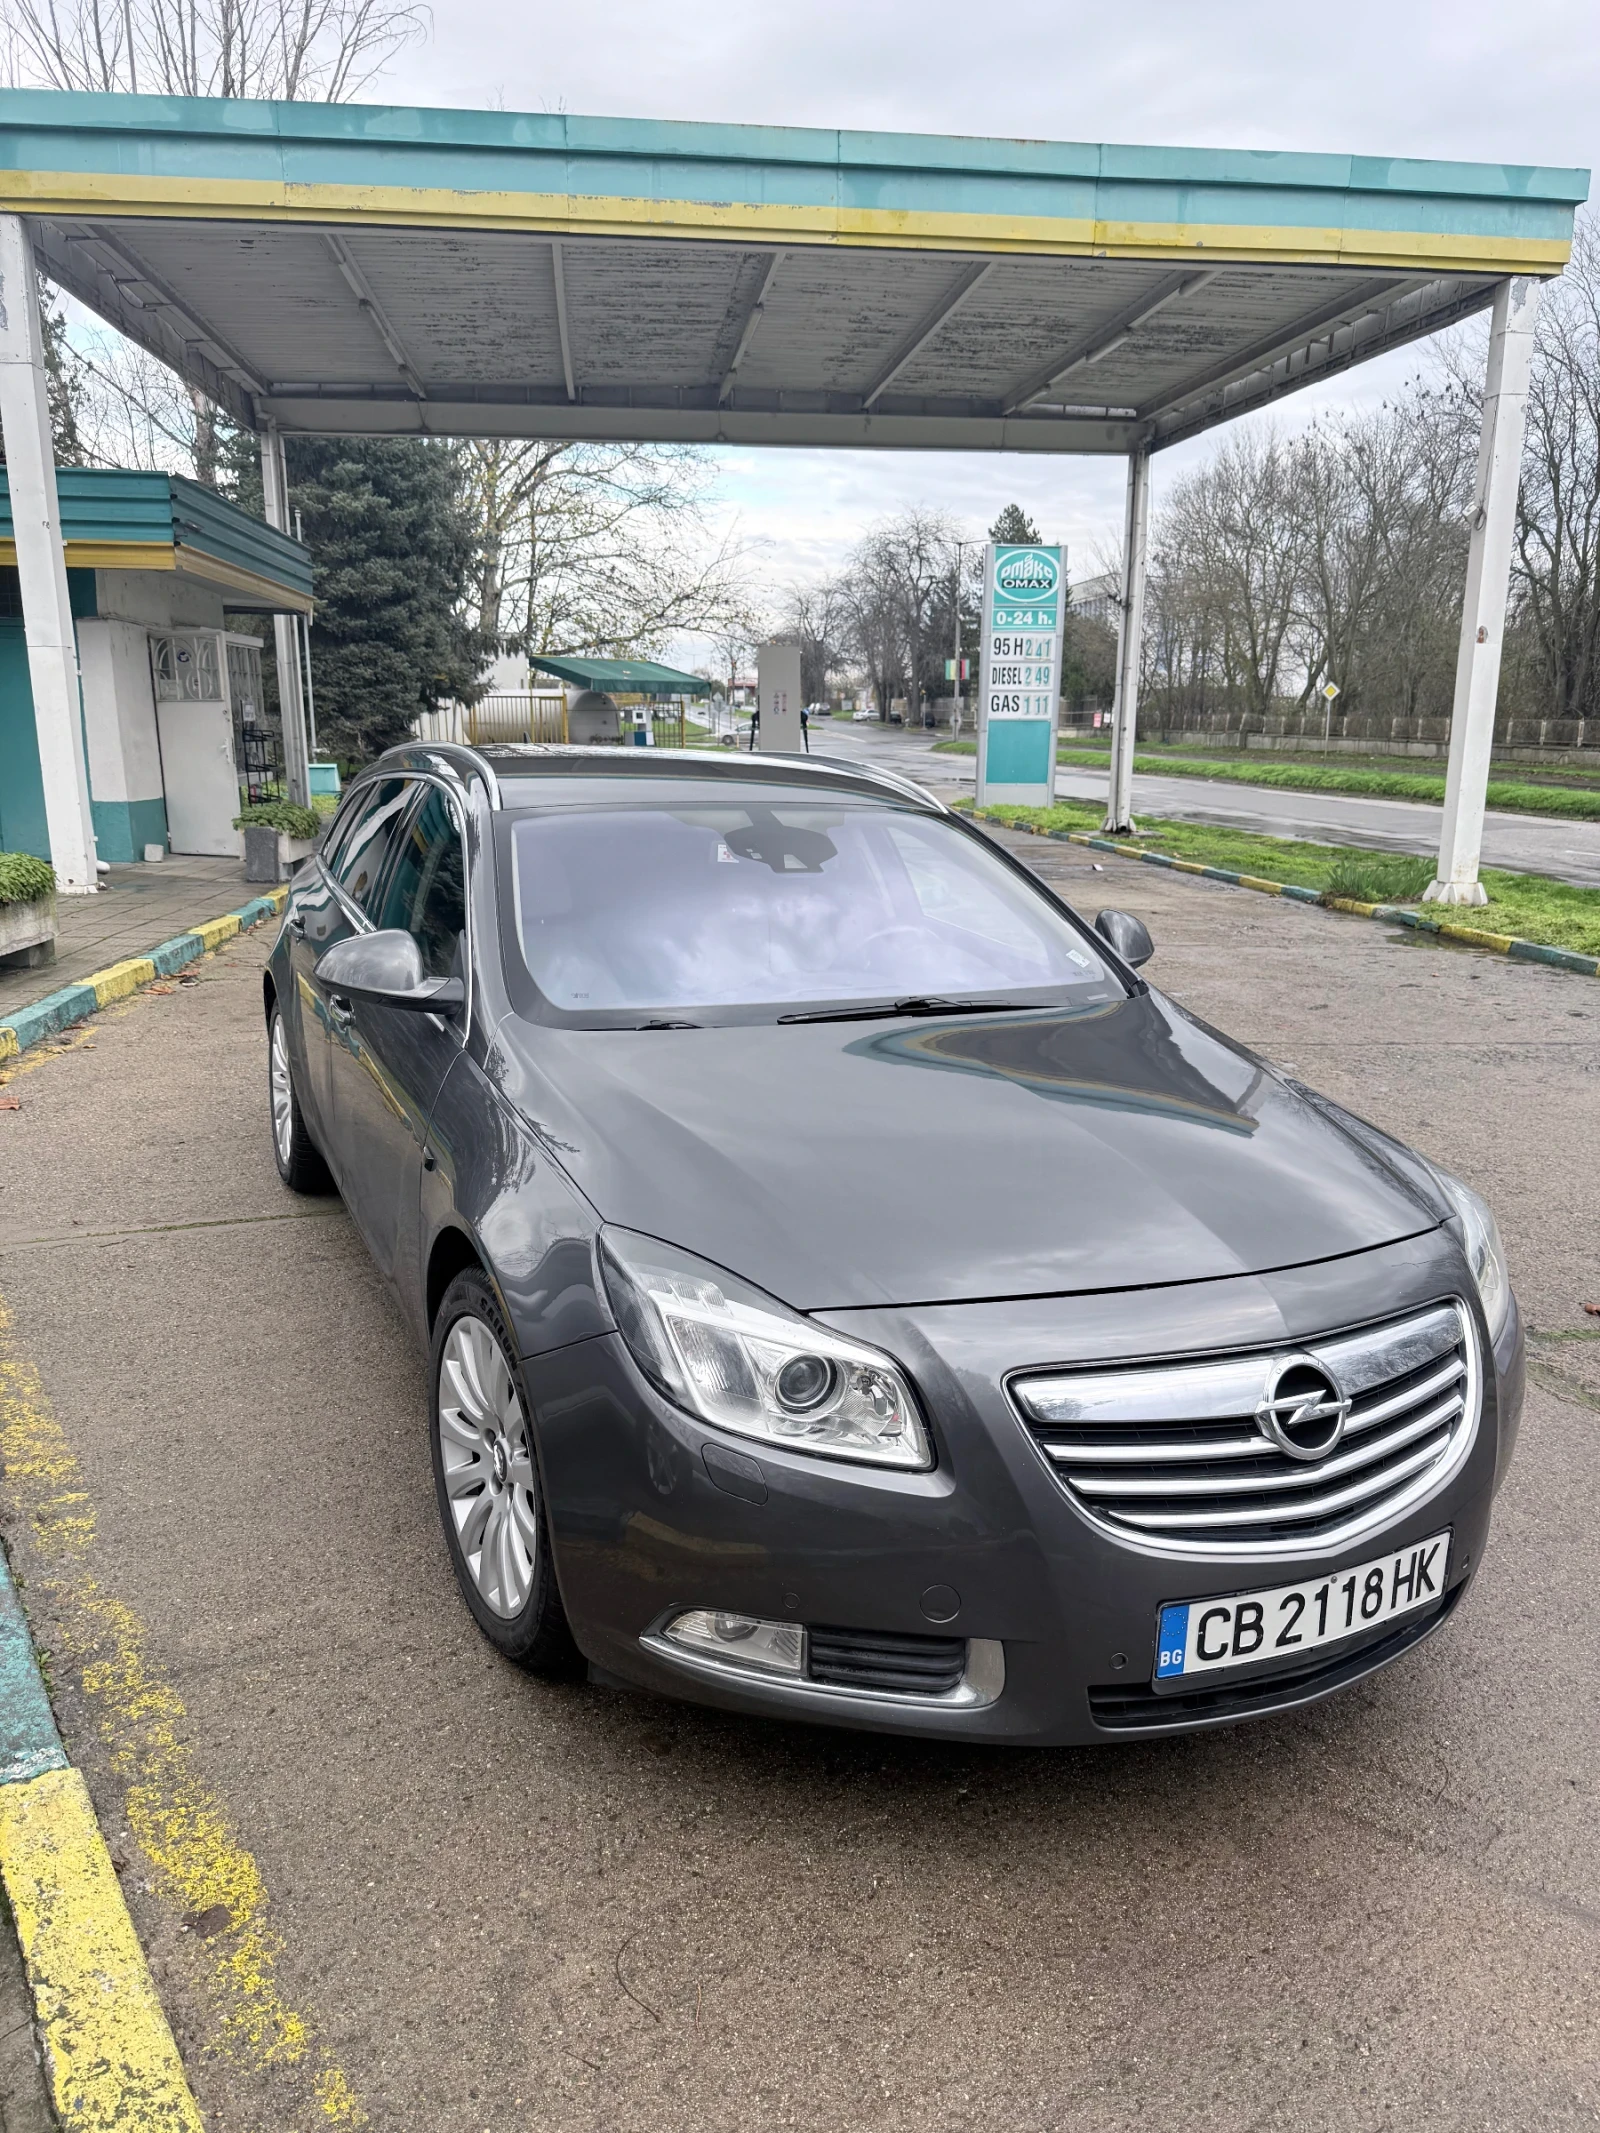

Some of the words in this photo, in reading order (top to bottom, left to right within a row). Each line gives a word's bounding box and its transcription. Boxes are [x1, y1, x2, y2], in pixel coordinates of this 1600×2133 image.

[1003, 580, 1050, 588] OMAX
[996, 611, 1033, 625] 0-24
[1038, 611, 1053, 625] h.
[993, 637, 1010, 655] 95
[992, 667, 1022, 685] DIESEL
[991, 695, 1020, 712] GAS
[480, 1297, 517, 1371] SAILUN
[1197, 1601, 1264, 1661] CB
[1275, 1567, 1385, 1648] 2118
[1390, 1542, 1441, 1610] HK
[1159, 1648, 1183, 1667] BG
